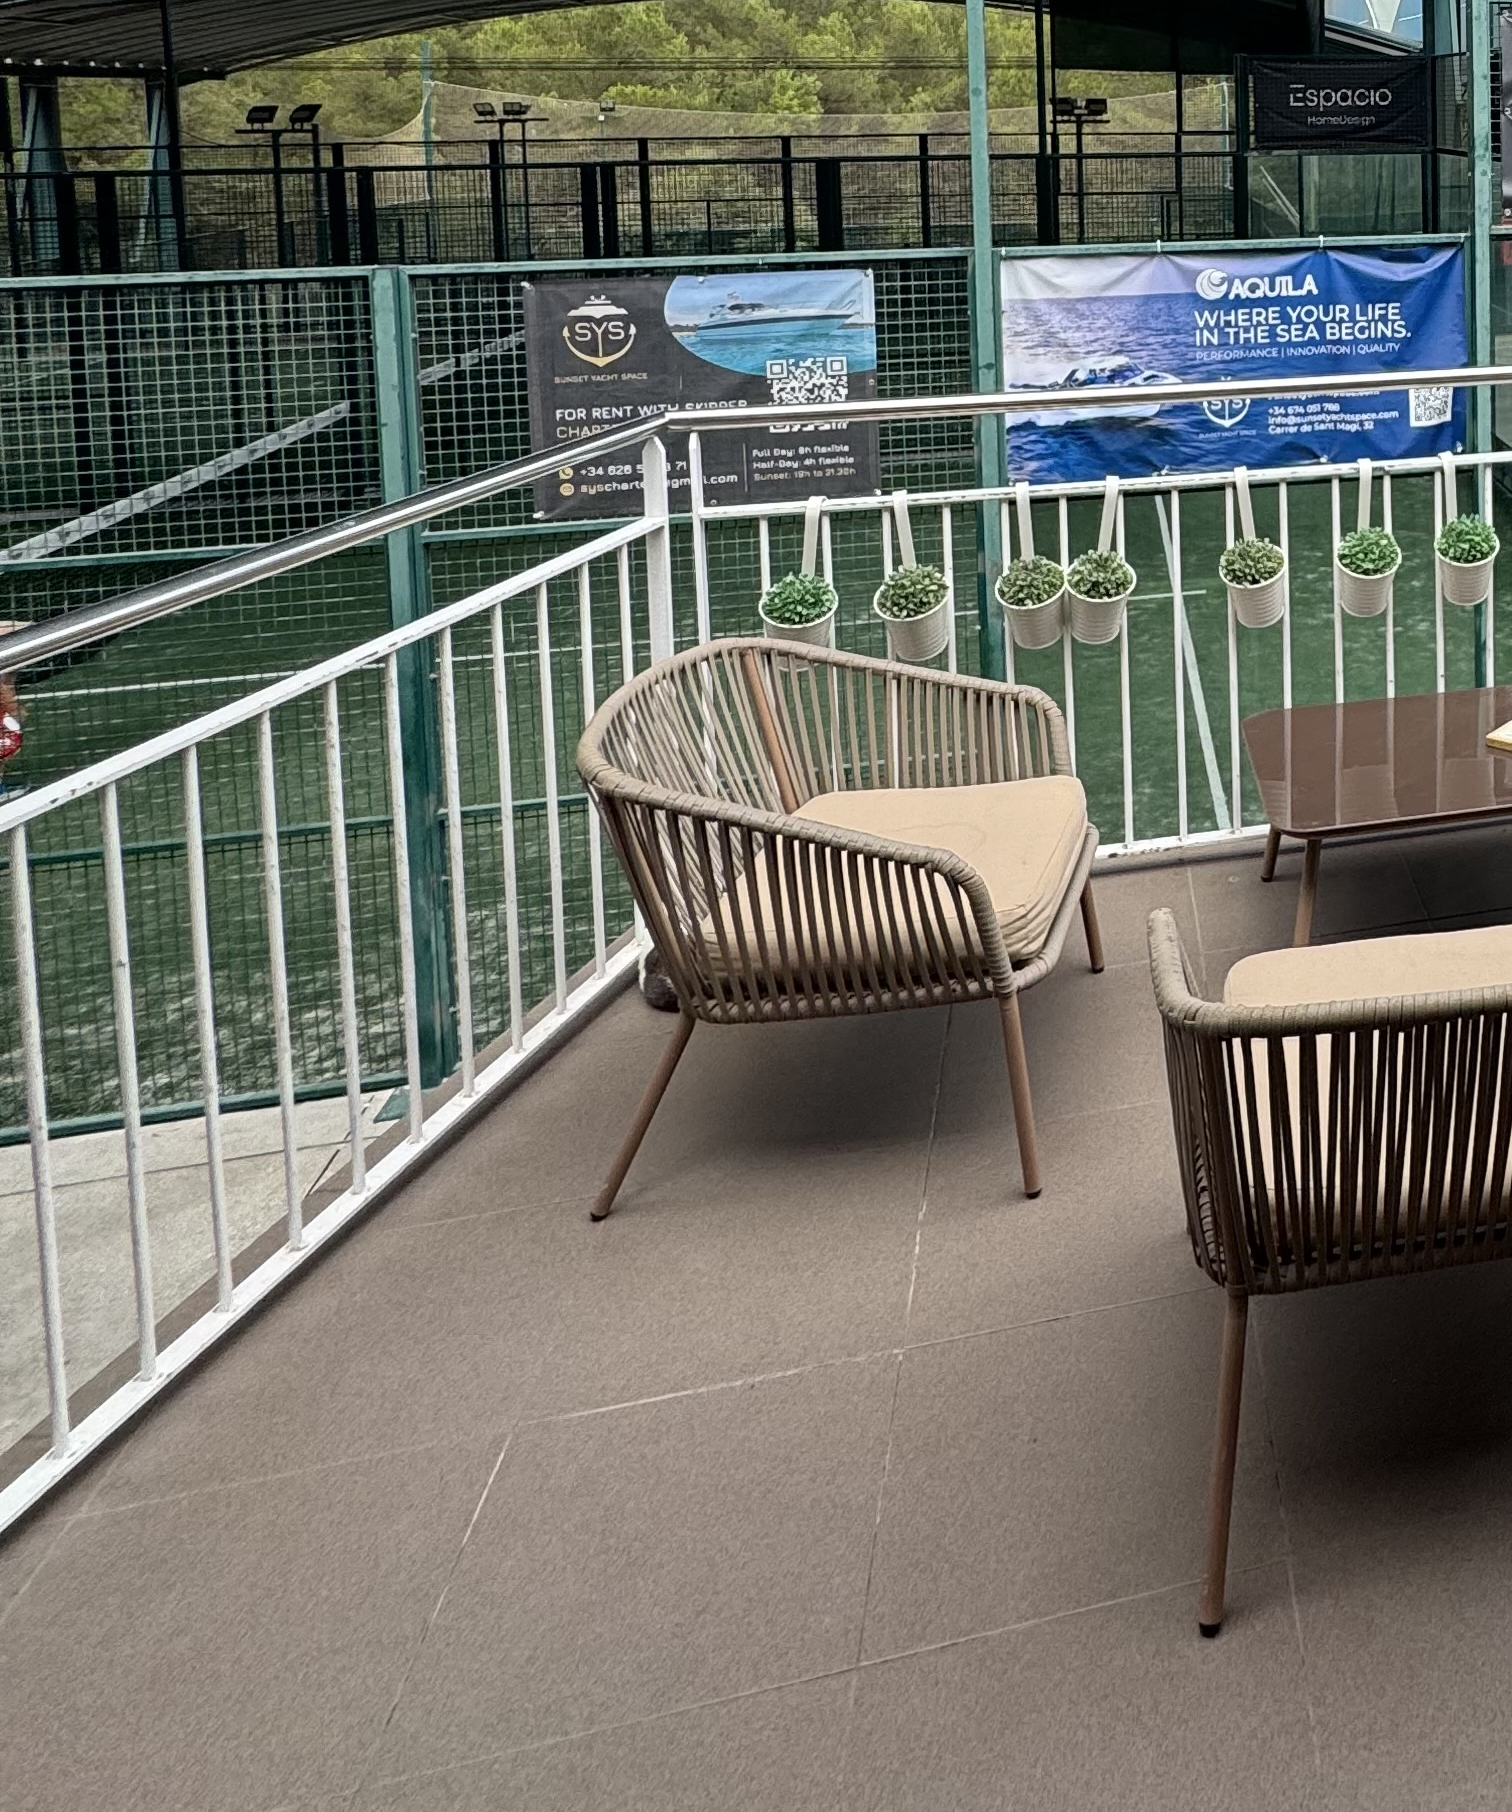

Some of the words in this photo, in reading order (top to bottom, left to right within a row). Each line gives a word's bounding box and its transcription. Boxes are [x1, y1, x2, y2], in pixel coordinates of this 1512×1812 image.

[1289, 84, 1393, 111] Espacio
[1307, 115, 1376, 126] HomeDesign
[1228, 274, 1319, 300] AQUILA
[1194, 307, 1282, 328] WHERE
[1286, 304, 1350, 323] YOUR
[1355, 302, 1401, 321] LIFE
[574, 321, 626, 355] SYS
[1196, 328, 1219, 347] IN
[1224, 325, 1270, 344] THE
[1276, 323, 1320, 342] SEA
[1326, 320, 1412, 340] BEGINS.
[1196, 347, 1279, 361] PERFORMANCE
[1286, 344, 1350, 357] INNOVATION
[1357, 342, 1400, 355] QUALITY
[555, 408, 587, 422] FOR
[592, 406, 634, 420] RENT
